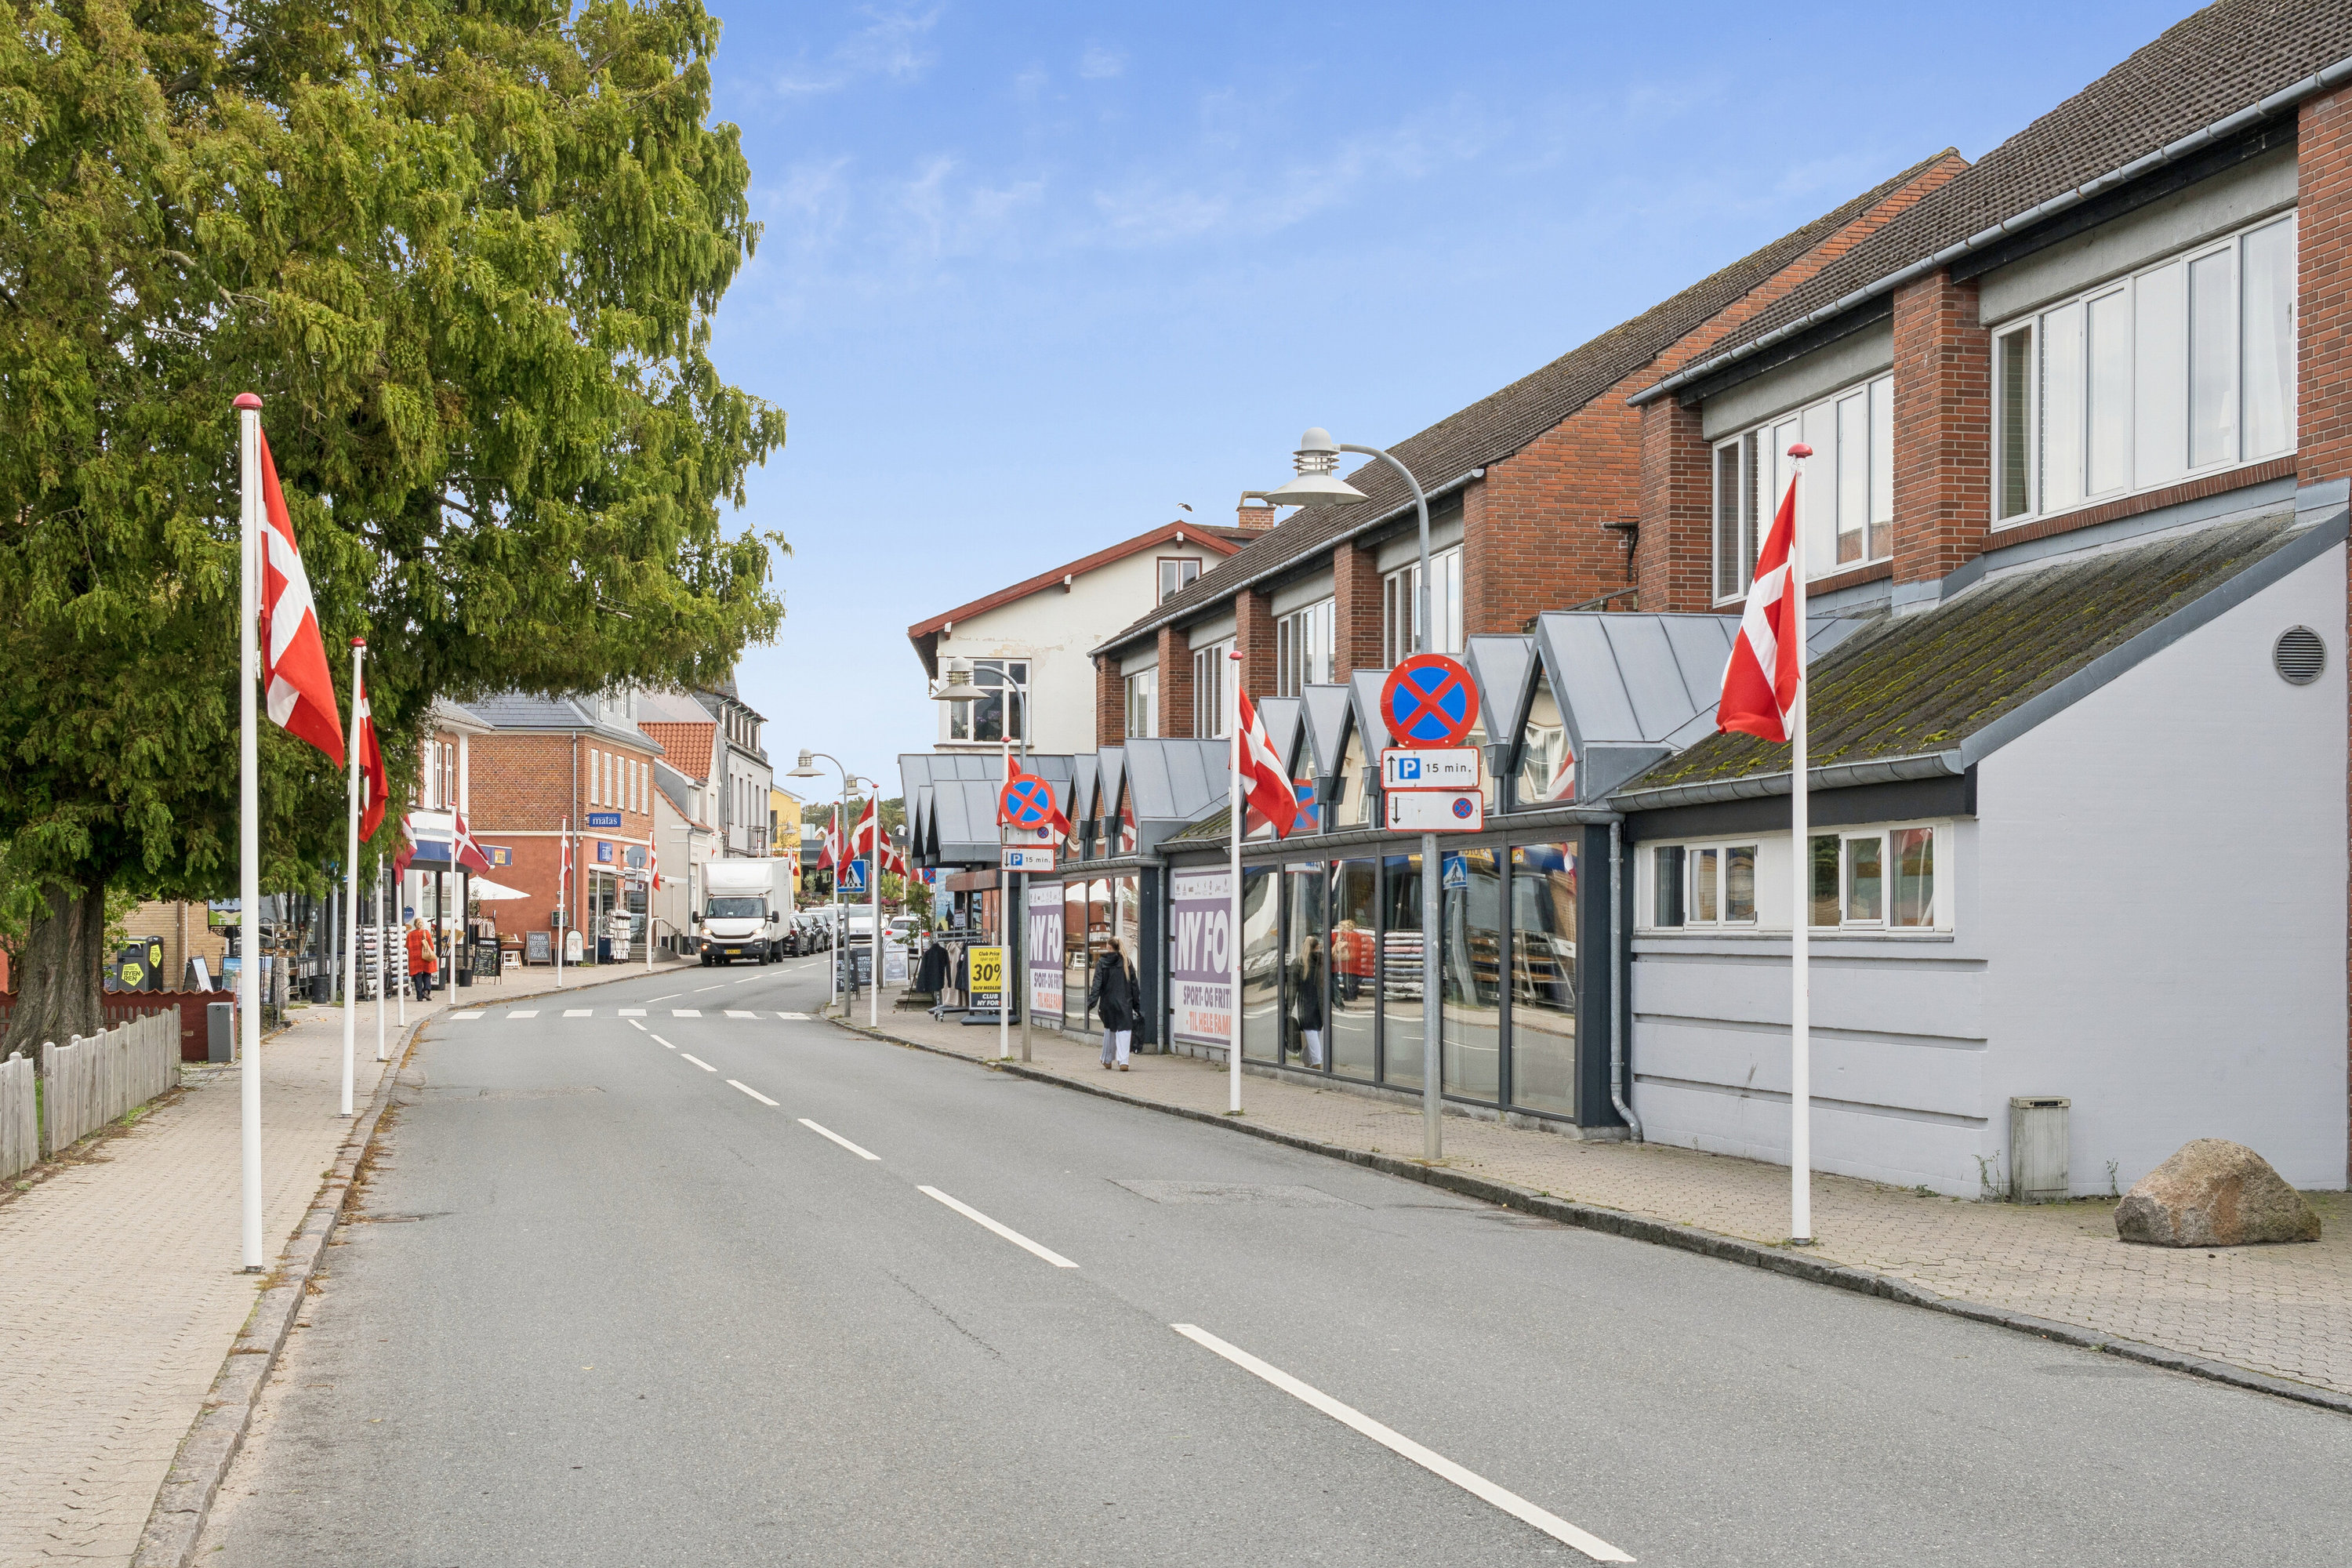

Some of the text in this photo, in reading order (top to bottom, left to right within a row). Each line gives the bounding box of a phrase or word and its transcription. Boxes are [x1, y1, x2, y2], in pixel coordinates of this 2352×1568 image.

[1403, 760, 1417, 778] P
[1426, 763, 1439, 773] 15
[592, 816, 618, 825] matas
[1029, 913, 1062, 963] NY FO
[1177, 909, 1231, 974] NY FO
[1204, 986, 1214, 1007] OG
[1189, 1011, 1198, 1032] TIL
[1199, 1012, 1214, 1033] HELE
